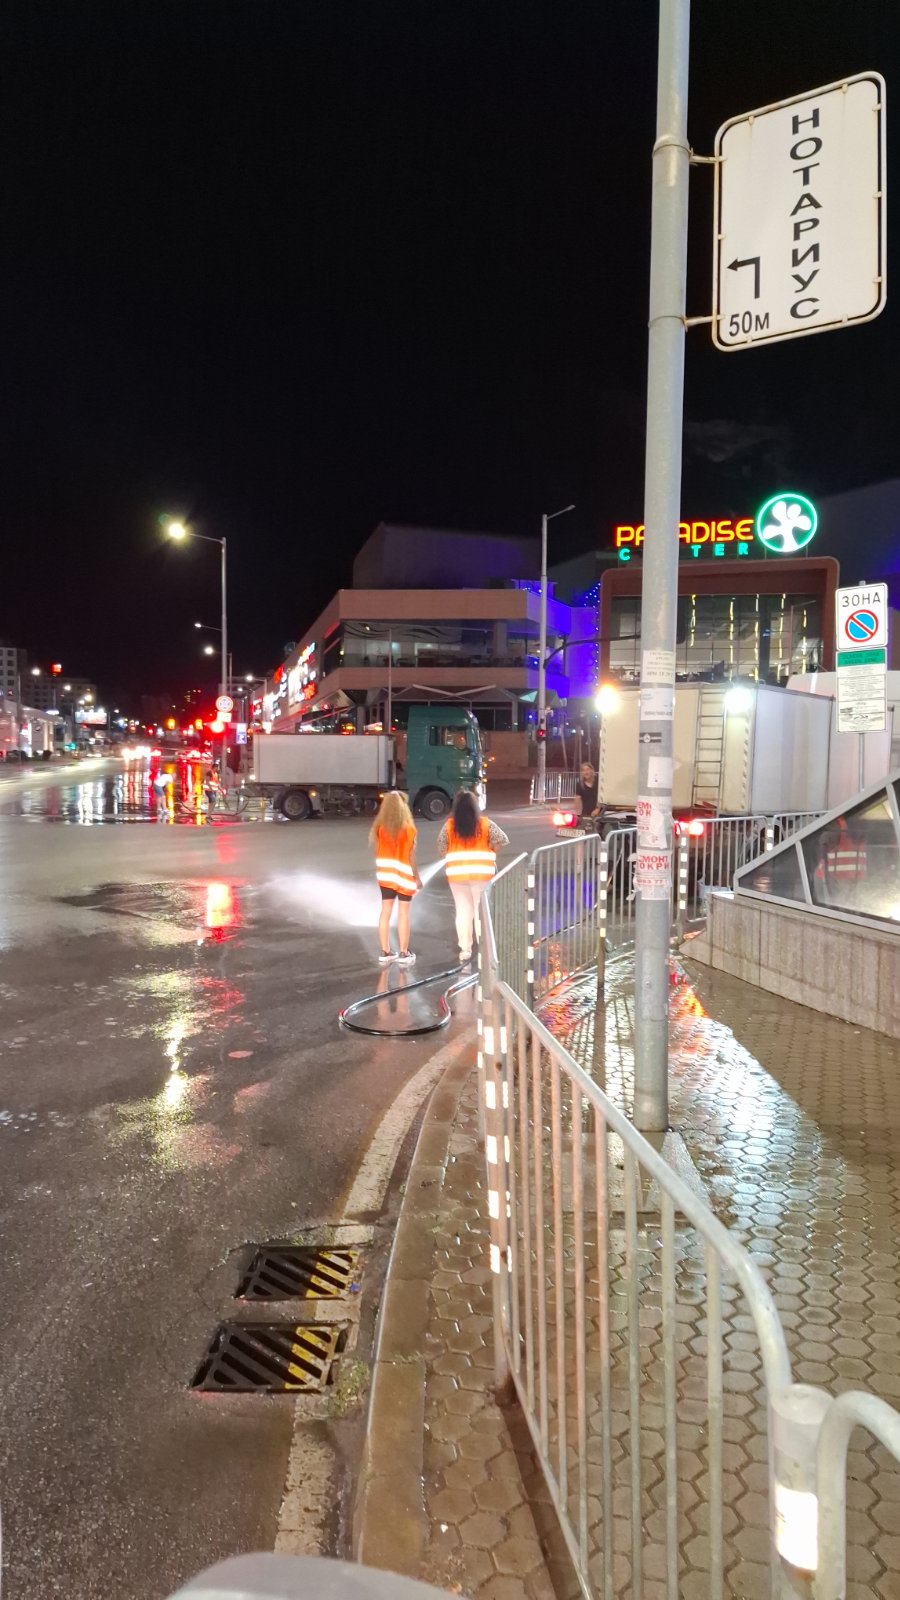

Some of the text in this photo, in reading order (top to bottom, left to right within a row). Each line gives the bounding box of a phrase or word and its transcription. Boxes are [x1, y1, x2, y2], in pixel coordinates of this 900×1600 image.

[789, 107, 823, 319] НОТАРИУС
[616, 519, 754, 547] PAADISE
[618, 542, 749, 561] CTER
[841, 591, 881, 608] ЗОНА
